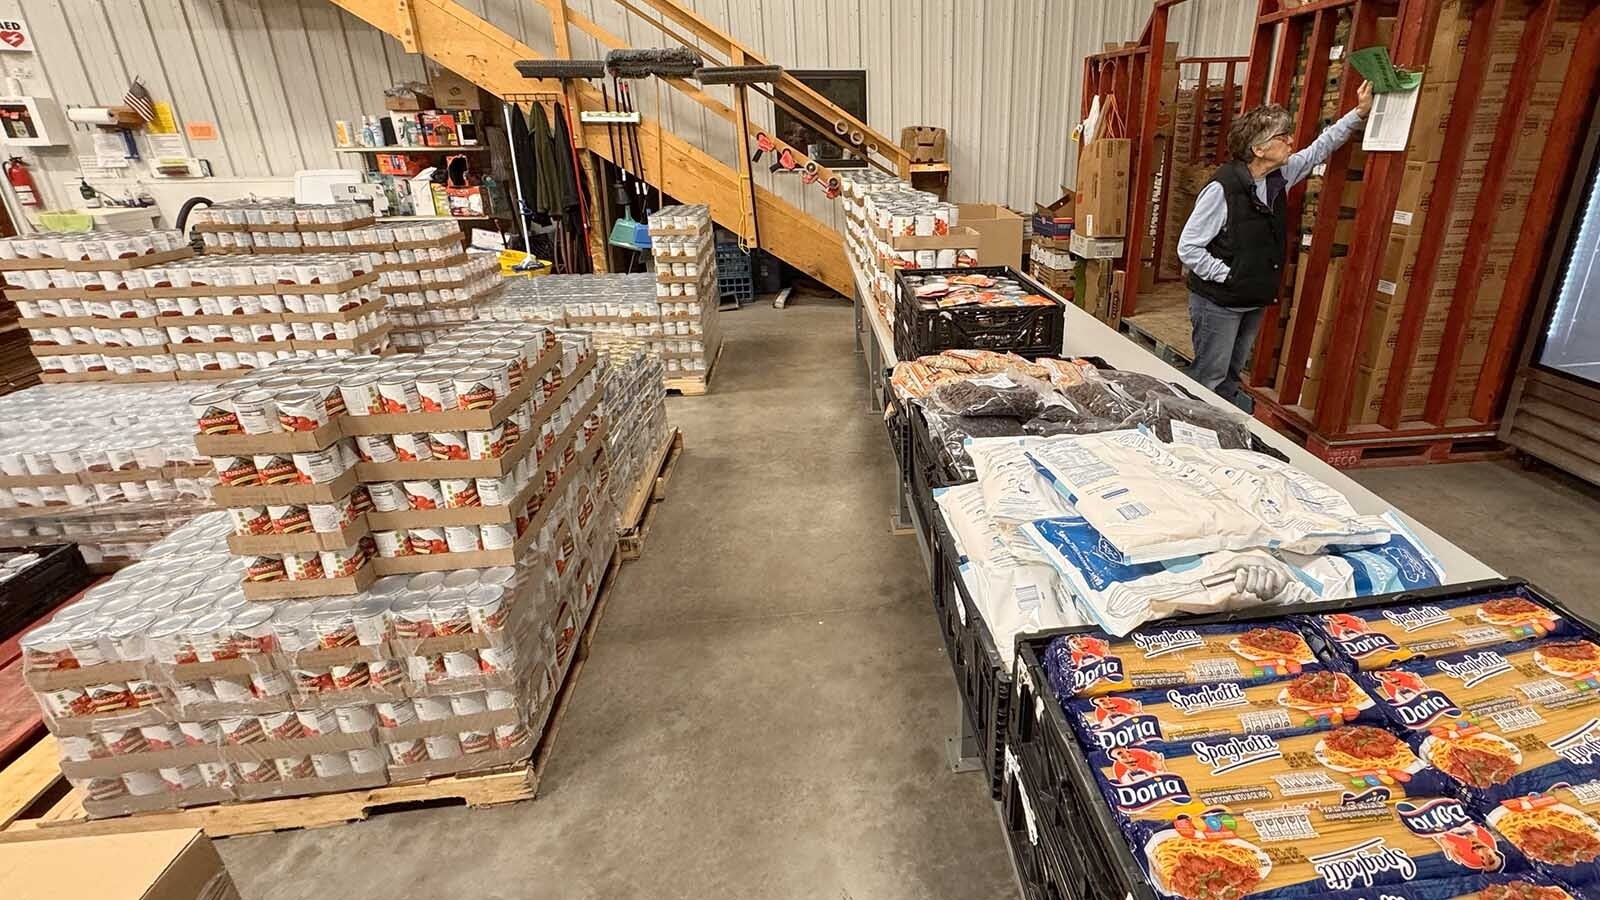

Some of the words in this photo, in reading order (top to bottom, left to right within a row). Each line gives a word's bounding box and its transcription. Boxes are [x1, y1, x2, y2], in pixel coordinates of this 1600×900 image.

[1328, 456, 1357, 466] PECO
[1384, 606, 1448, 629] Spaghetti
[1133, 629, 1201, 650] Spaghetti
[1343, 633, 1388, 655] Doria
[1074, 659, 1120, 688] Doria
[1437, 650, 1505, 678] Spaghetti
[1169, 684, 1244, 709] Spaghetti
[1400, 695, 1449, 725] Doria
[1101, 718, 1156, 750] Doria
[1193, 735, 1277, 767] Spaghetti
[1118, 775, 1182, 807] Doria
[1408, 803, 1470, 831] Doria
[1318, 847, 1415, 888] Spaghetti
